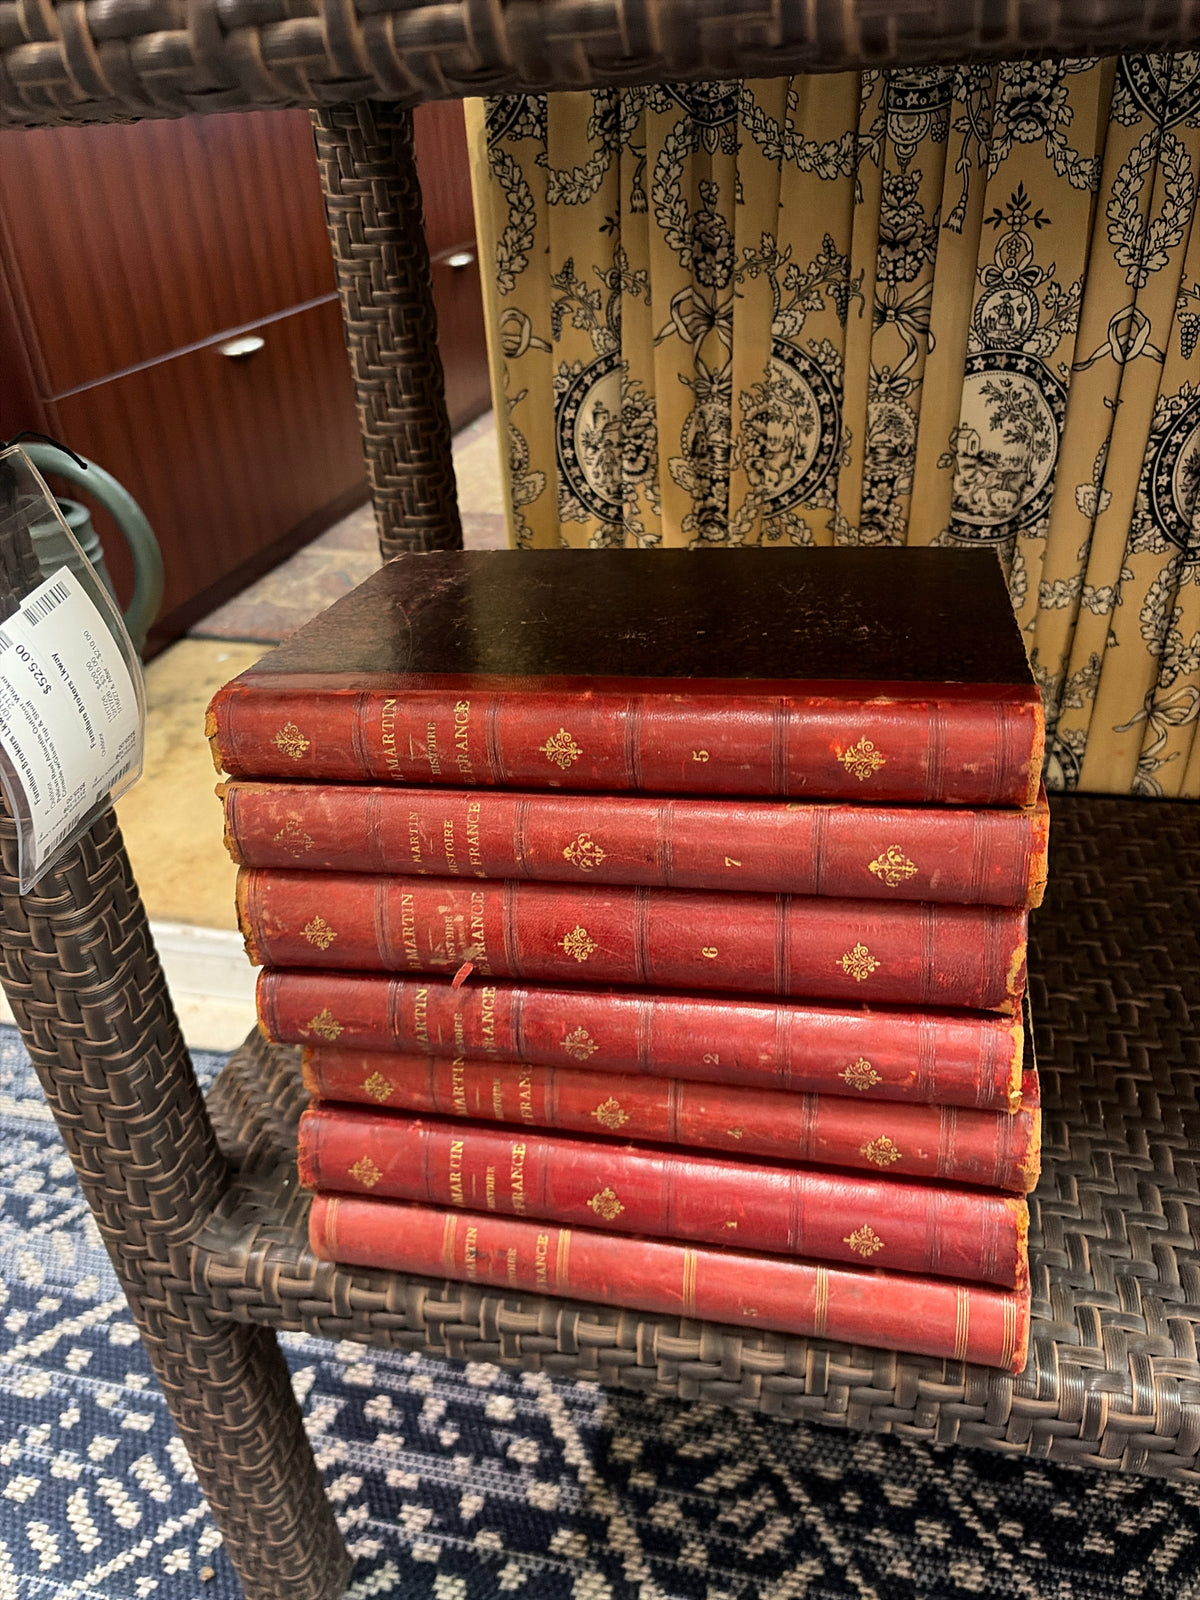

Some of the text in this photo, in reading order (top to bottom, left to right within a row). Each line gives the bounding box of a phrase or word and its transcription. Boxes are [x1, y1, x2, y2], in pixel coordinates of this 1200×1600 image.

[15, 644, 52, 695] $525.00
[83, 629, 102, 660] $210.00
[1, 675, 20, 704] Wicker
[51, 652, 97, 749] Furniture Brokers Lkway
[20, 702, 39, 734] Outdoor
[382, 698, 401, 773] MARTIN
[454, 700, 474, 775] FRANCE
[10, 735, 28, 770] Brokers
[427, 721, 441, 775] HISTOIRE
[692, 749, 709, 763] 5
[26, 768, 42, 806] Furniture
[409, 811, 422, 864] MARTIN
[444, 819, 460, 874] HISTOIRE
[467, 802, 482, 867] FRANCE
[724, 855, 742, 867] 7
[402, 893, 420, 964] MARTIN
[470, 891, 489, 961] FRANCE
[701, 946, 719, 958] 6
[702, 1053, 720, 1065] 2
[519, 1064, 534, 1119] FRANC
[726, 1128, 743, 1140] 4
[450, 1140, 464, 1208] MARTIN
[510, 1143, 527, 1210] FRANCE
